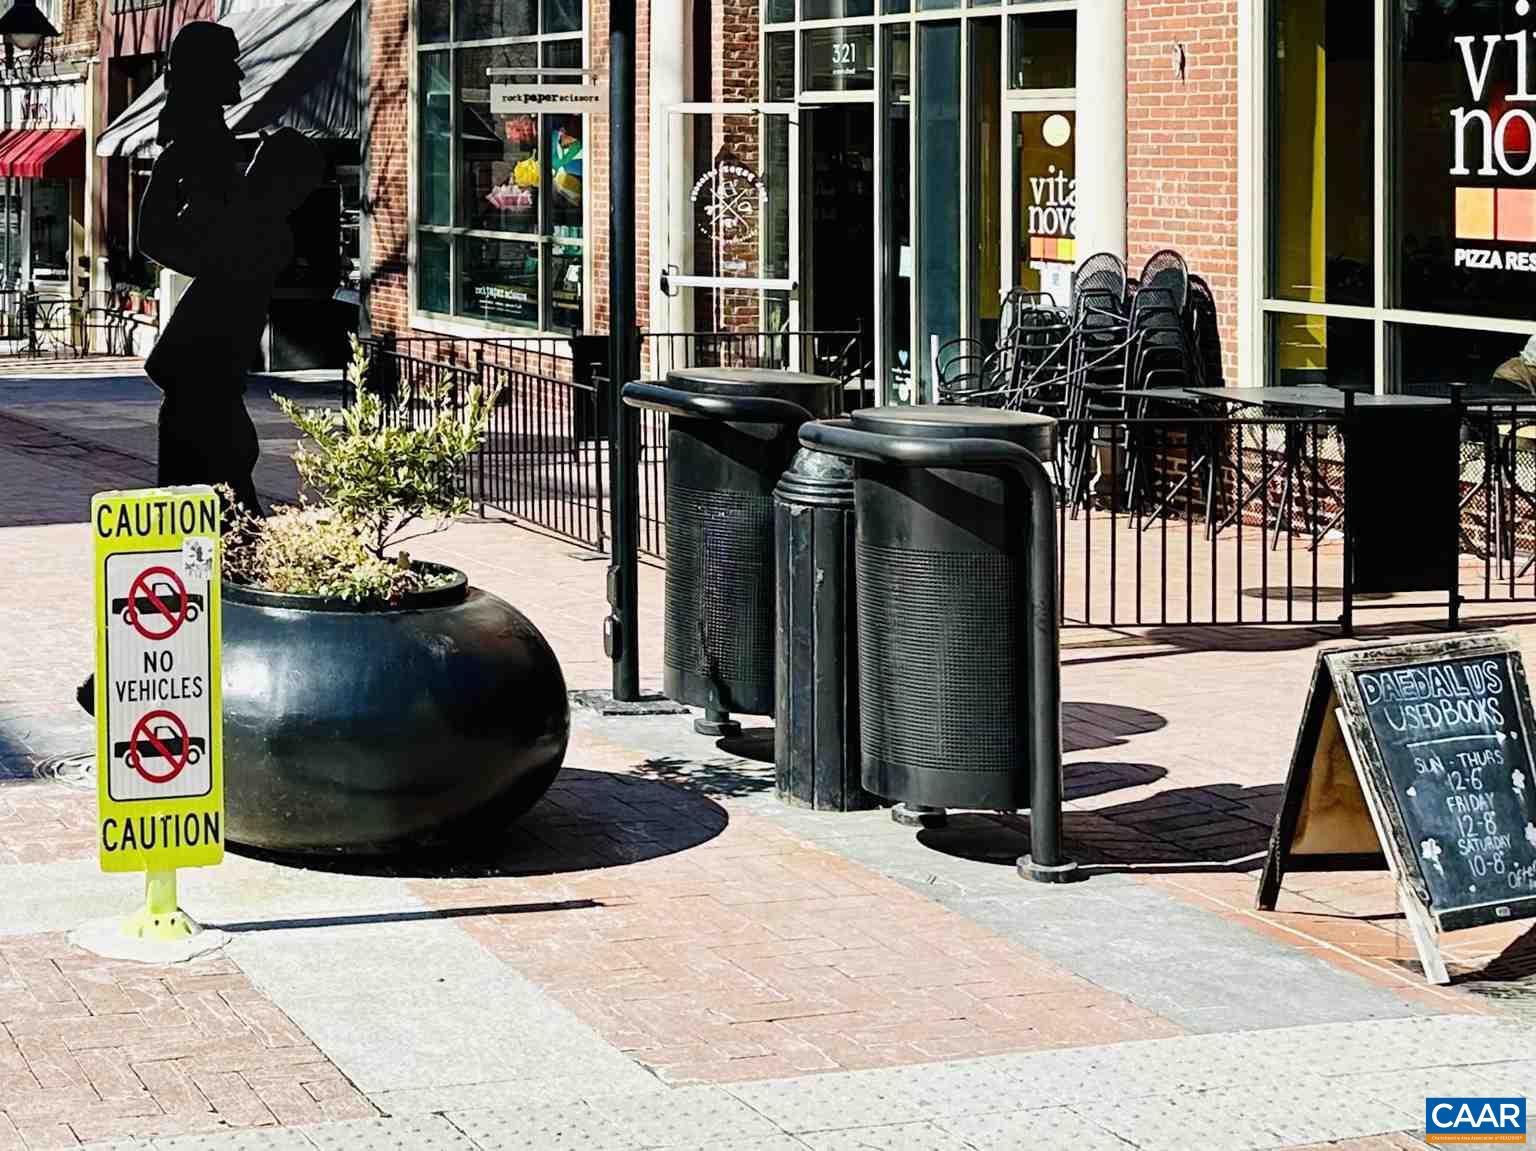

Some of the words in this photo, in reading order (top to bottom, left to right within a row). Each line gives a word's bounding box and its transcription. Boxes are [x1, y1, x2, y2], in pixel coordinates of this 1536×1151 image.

[832, 42, 856, 64] 321
[1454, 248, 1503, 270] PIZZA
[96, 499, 216, 538] CAUTION
[143, 650, 174, 674] NO
[115, 675, 203, 703] VEHICLES
[1358, 660, 1504, 706] DAEDALUS
[1414, 755, 1445, 774] SUN
[1456, 749, 1504, 768] THURS
[1446, 792, 1495, 814] FRIDAY
[102, 811, 220, 852] CAUTION
[1457, 833, 1513, 856] SATURDAY
